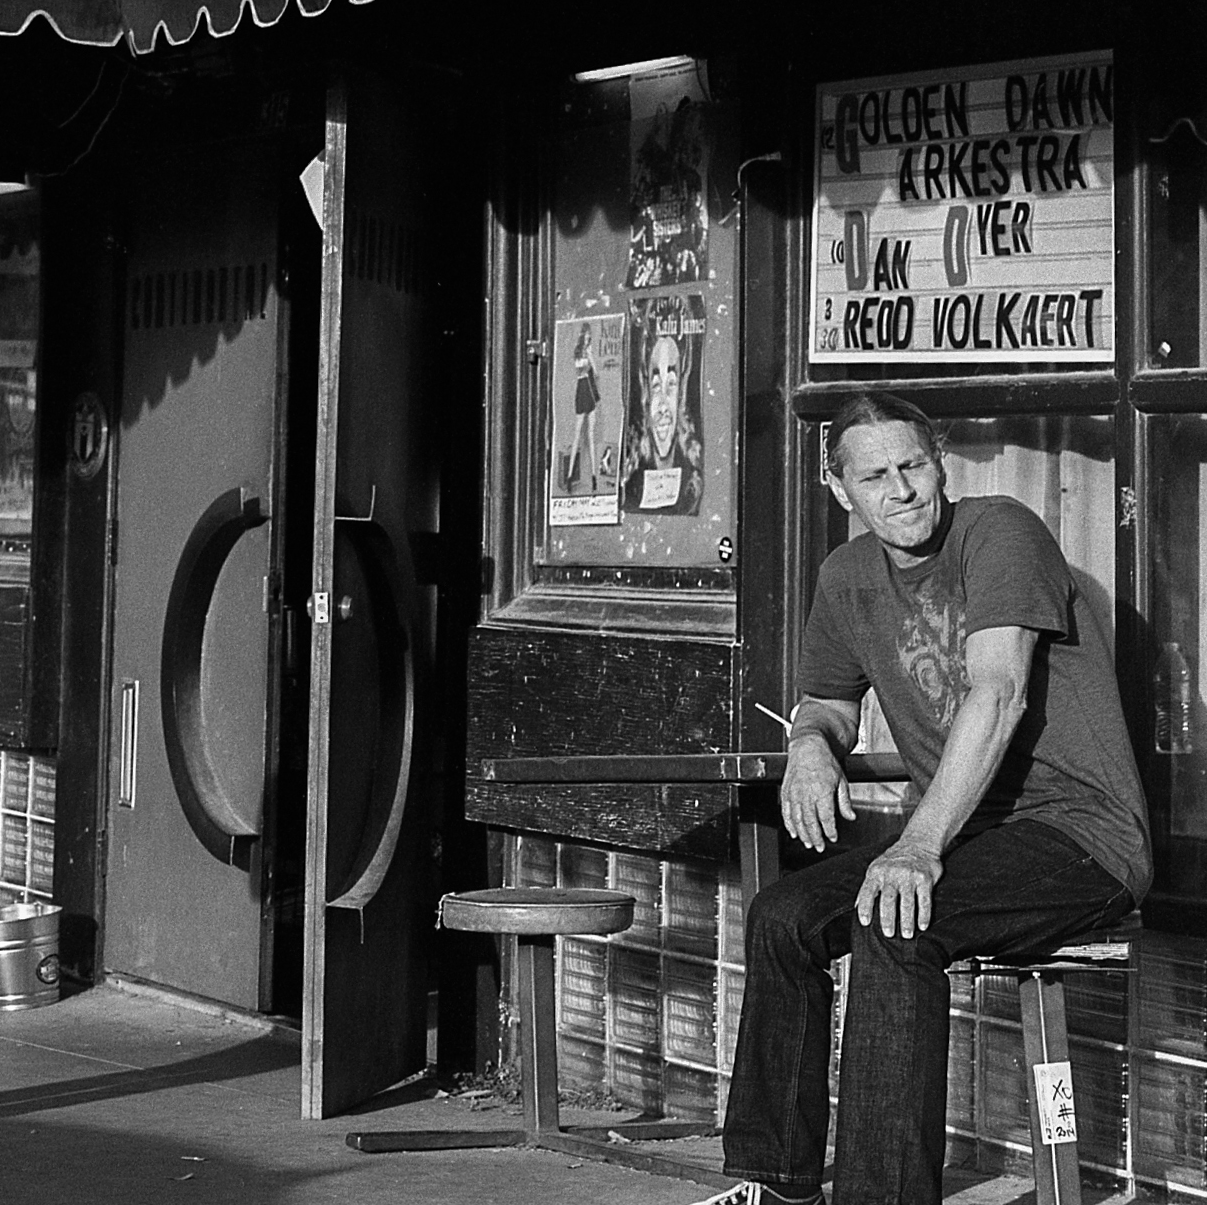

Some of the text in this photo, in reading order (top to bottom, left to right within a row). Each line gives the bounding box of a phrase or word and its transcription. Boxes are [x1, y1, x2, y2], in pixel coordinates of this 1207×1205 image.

[835, 81, 970, 174] GOLDEN
[1004, 64, 1113, 133] DAWN
[899, 133, 1088, 202] ARKESTRA
[844, 210, 913, 292] DAN
[943, 200, 1032, 288] DYER
[932, 289, 1104, 350] VOLKAERT
